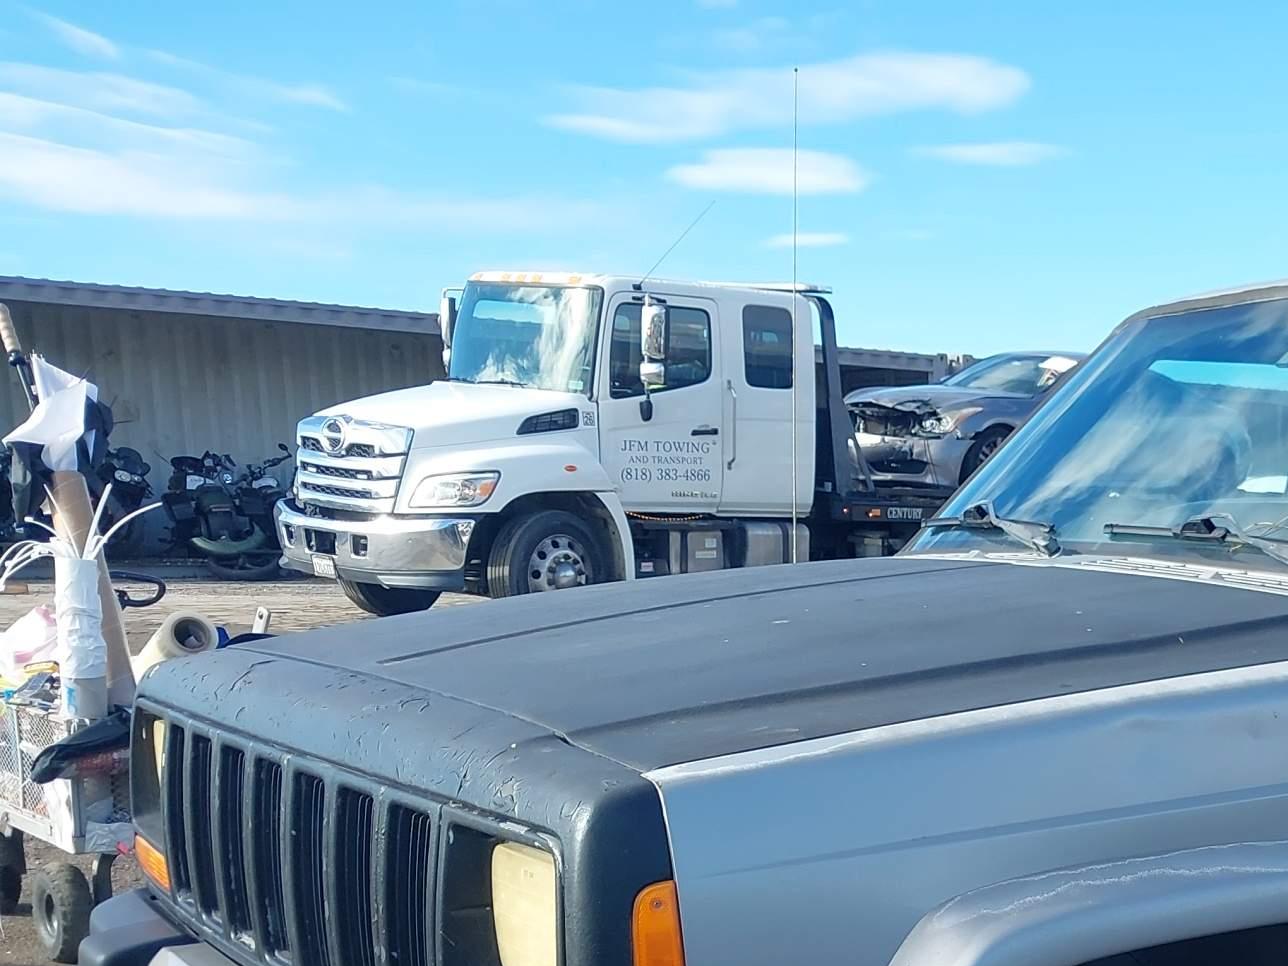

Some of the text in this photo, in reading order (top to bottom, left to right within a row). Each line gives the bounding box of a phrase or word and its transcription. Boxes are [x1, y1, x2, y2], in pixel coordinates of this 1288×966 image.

[621, 440, 710, 453] JFM TOWING
[628, 456, 703, 465] AND TRANSPORT
[621, 468, 711, 483] (818) 383-4866
[887, 507, 922, 519] CENTURY
